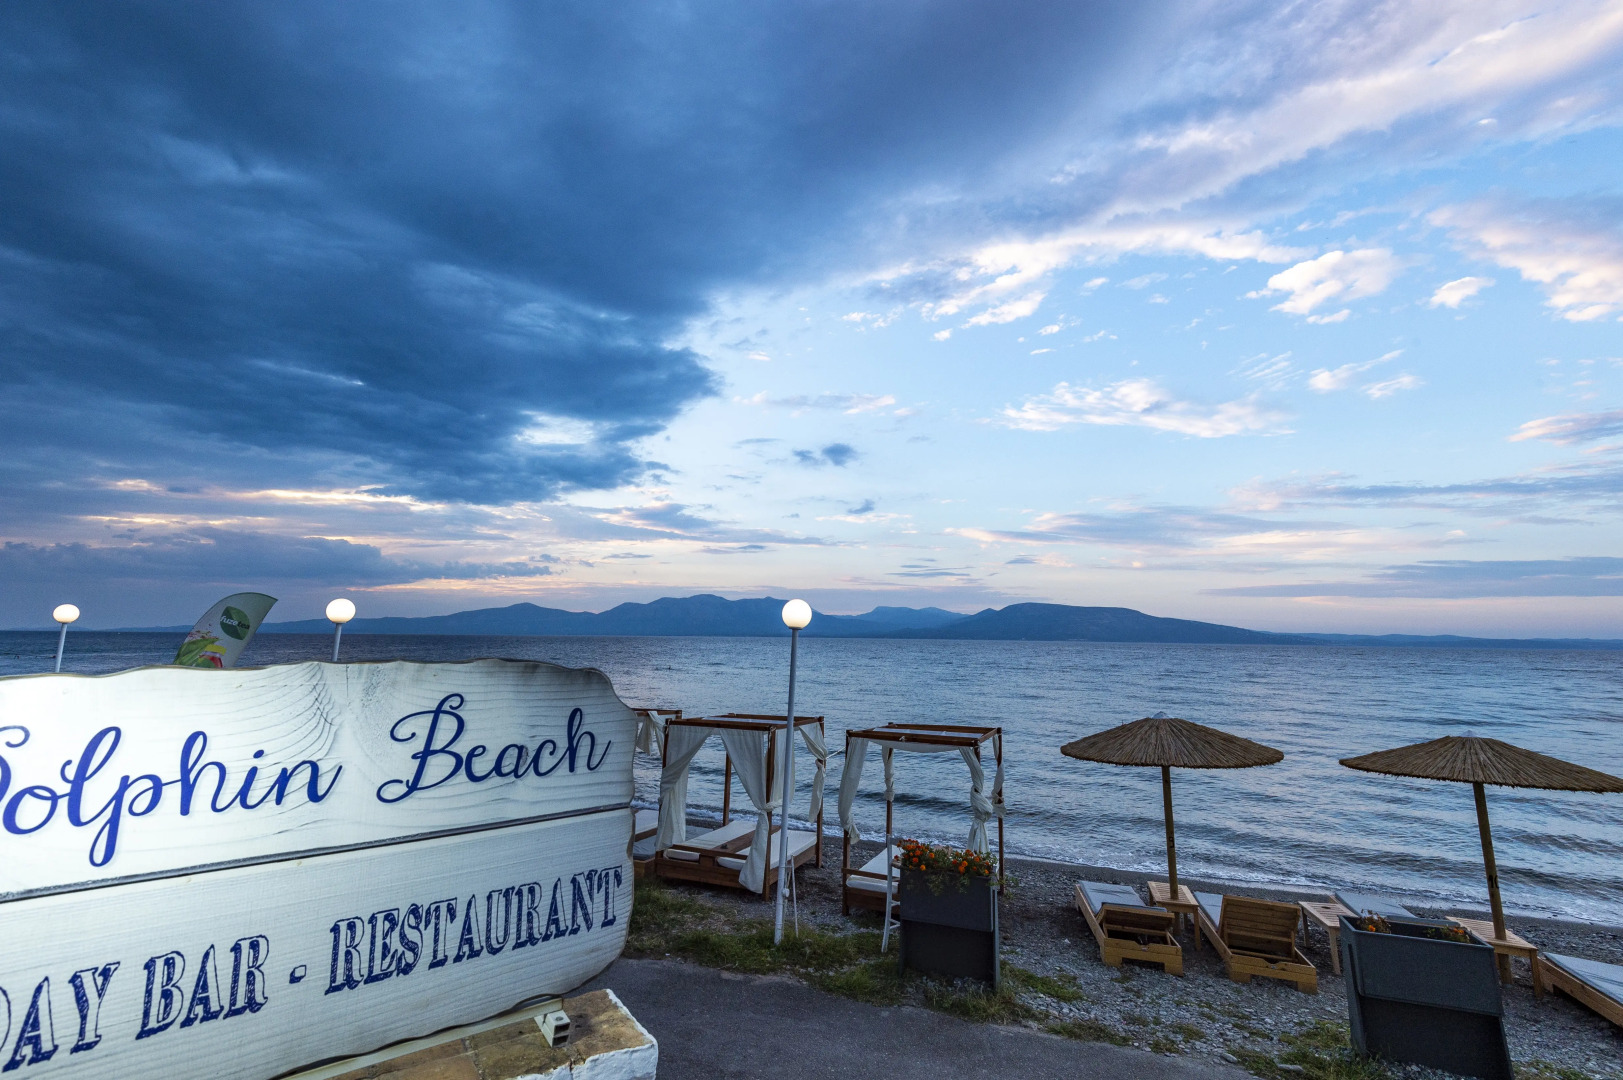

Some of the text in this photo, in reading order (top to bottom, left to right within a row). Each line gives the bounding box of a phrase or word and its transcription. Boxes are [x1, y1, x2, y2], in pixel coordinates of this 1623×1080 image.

[376, 692, 612, 805] Beach
[0, 961, 121, 1073] AY
[135, 934, 271, 1041] BAR
[324, 865, 624, 995] RESTAURANT
